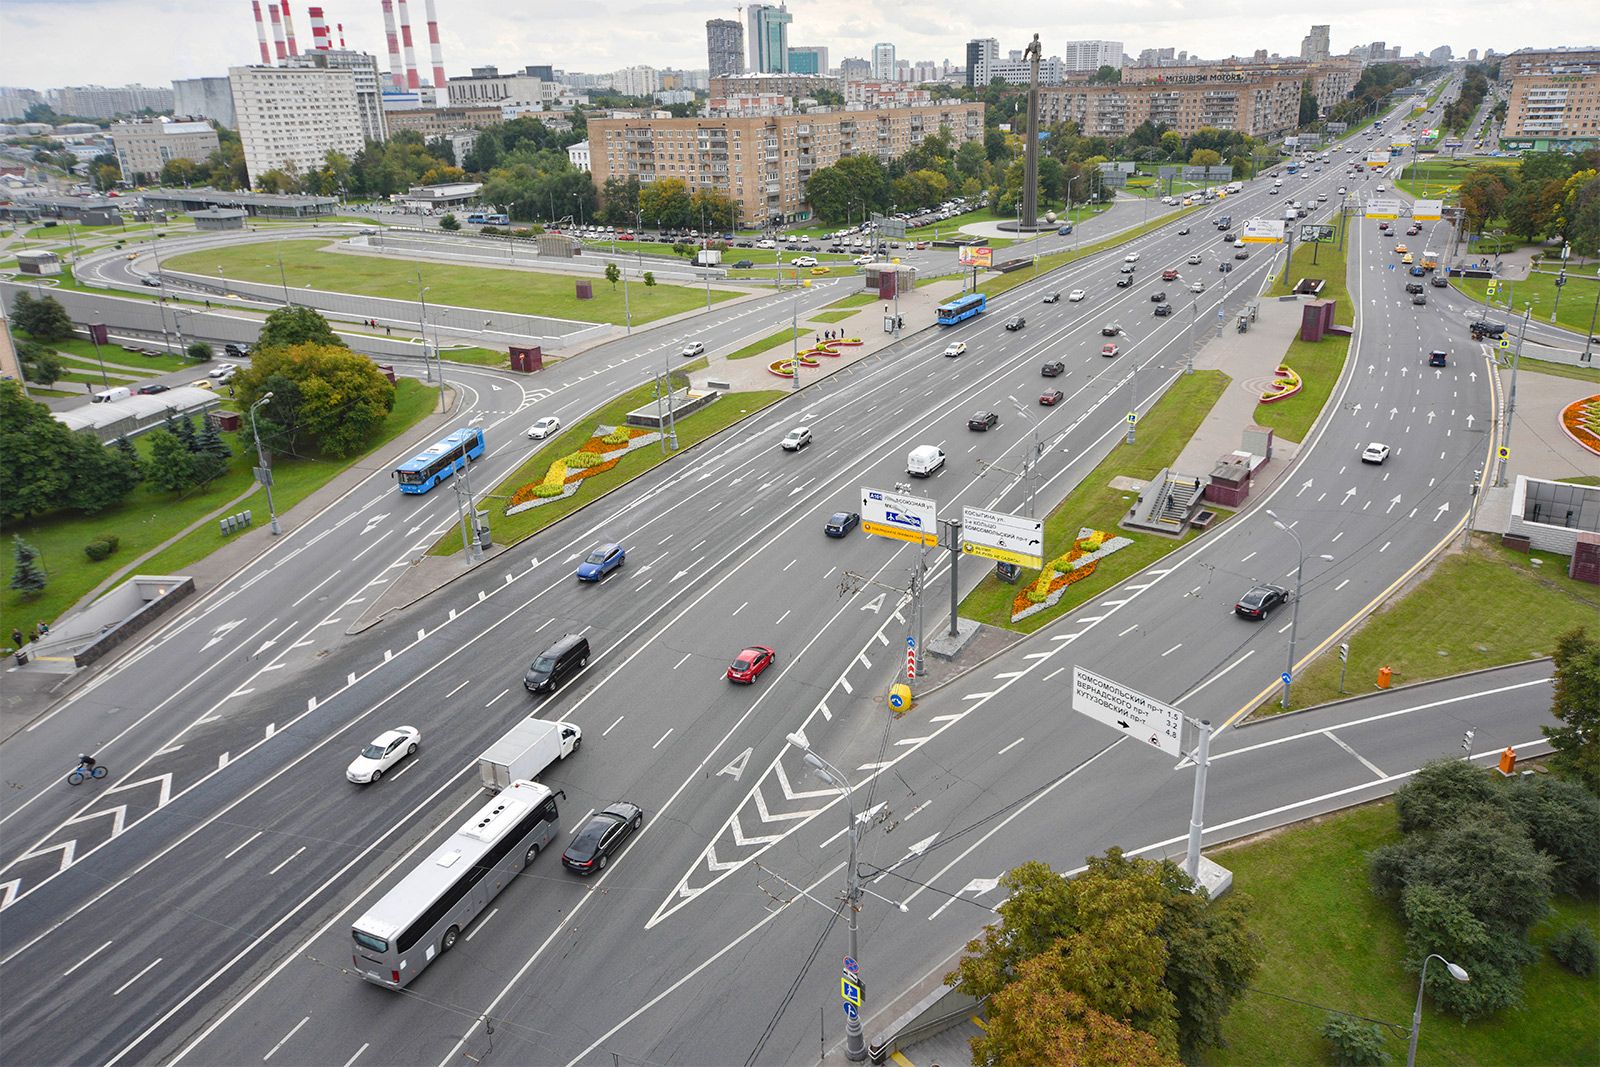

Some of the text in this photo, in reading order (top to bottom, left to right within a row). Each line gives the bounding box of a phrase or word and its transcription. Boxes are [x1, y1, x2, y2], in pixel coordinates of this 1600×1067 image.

[1210, 73, 1244, 81] MOTORS
[964, 509, 996, 521] КОСЫГИНА
[964, 525, 1015, 540] КОМСОМОЛЬСКИЙ
[973, 520, 997, 530] КОЛЬЦО
[1077, 671, 1179, 721] КОМСОМОЛЬСКИЙ пр-т 1.5
[1076, 680, 1177, 729] ВЕРНАДСКОГО пр-т 3.2
[1076, 688, 1177, 739] КУТУЗОВСКИЙ пр-т 4.8
